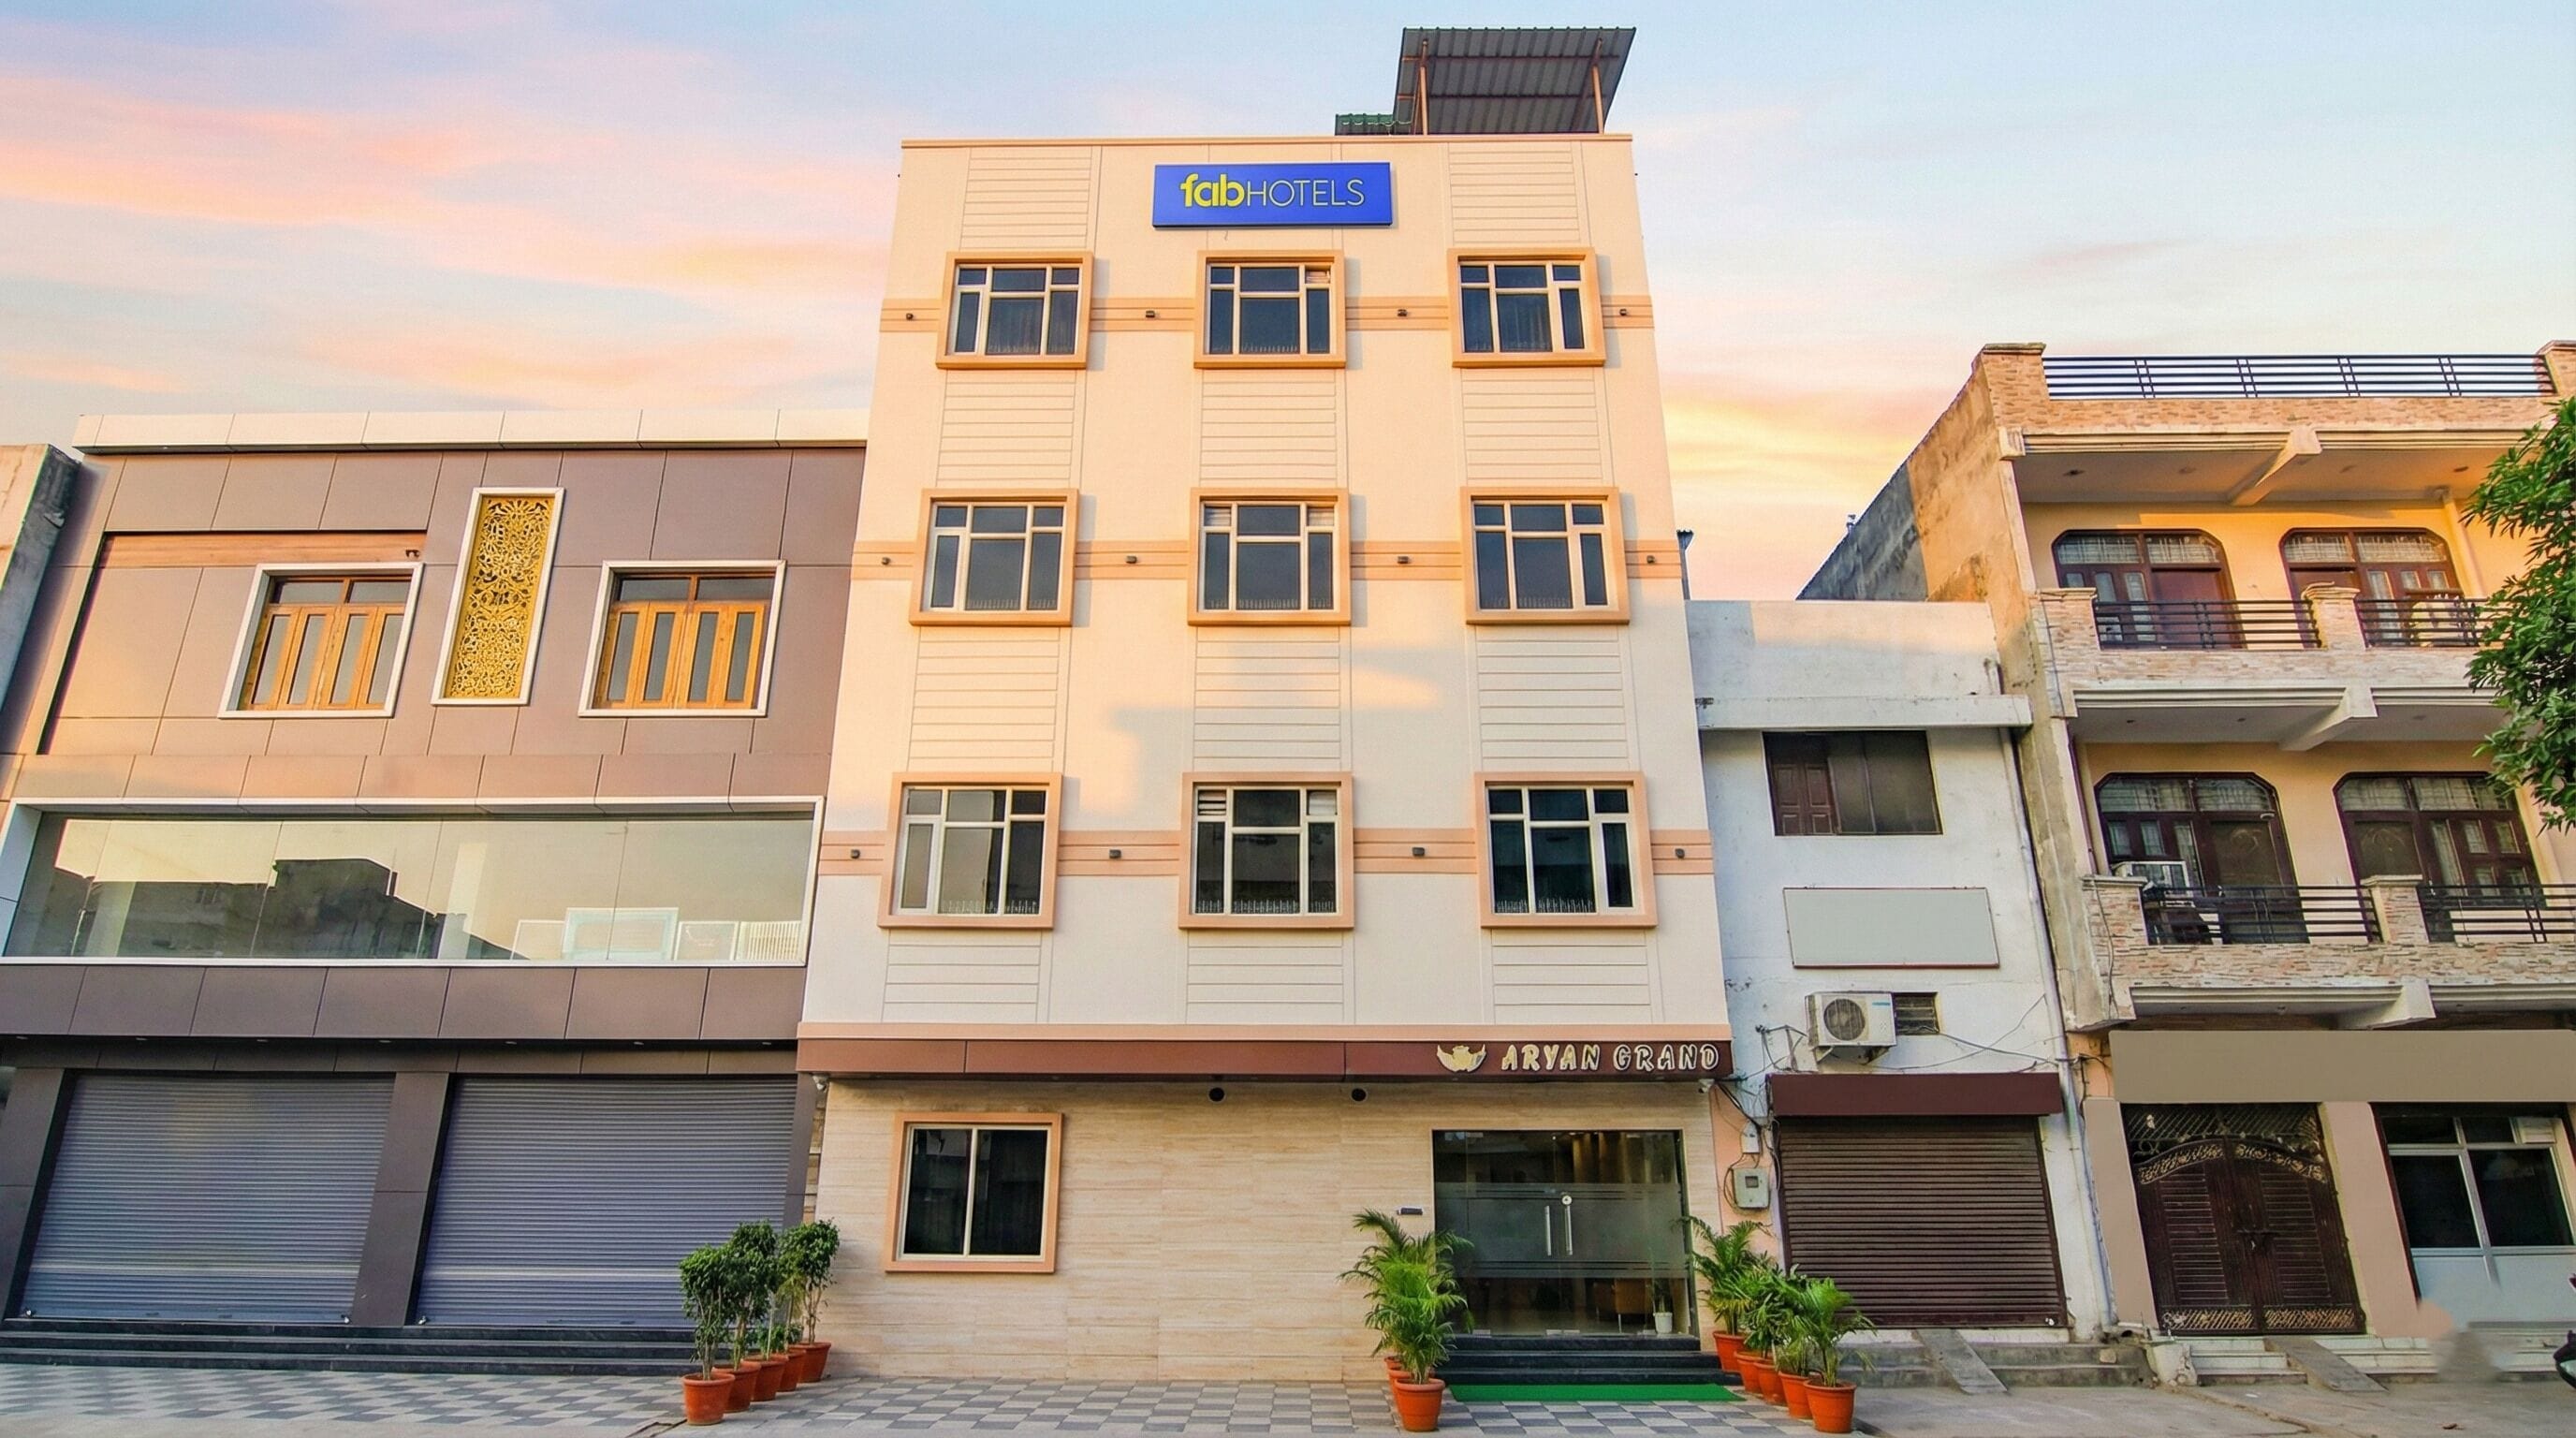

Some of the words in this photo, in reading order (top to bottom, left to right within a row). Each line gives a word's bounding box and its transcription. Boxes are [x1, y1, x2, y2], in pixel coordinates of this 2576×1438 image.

[1180, 173, 1365, 208] fabHOTELS
[1501, 1044, 1601, 1071] ARYAN
[1613, 1044, 1720, 1072] GRAND
